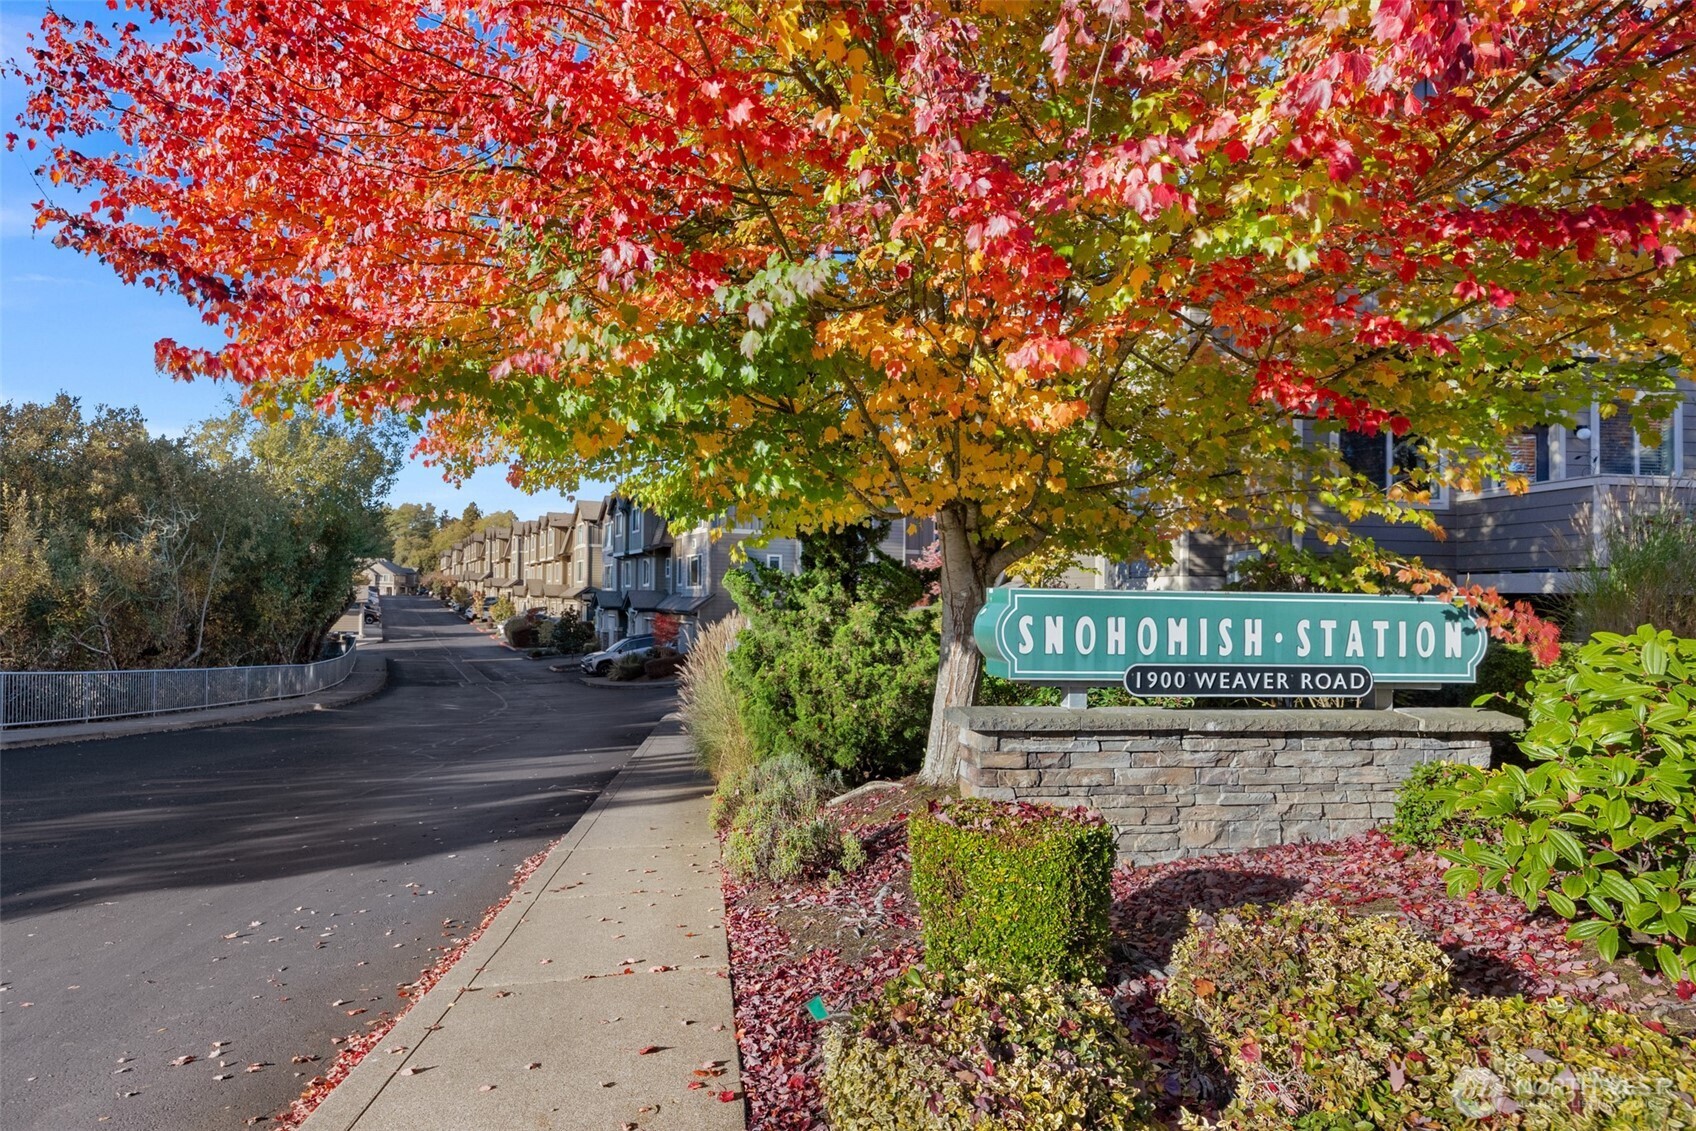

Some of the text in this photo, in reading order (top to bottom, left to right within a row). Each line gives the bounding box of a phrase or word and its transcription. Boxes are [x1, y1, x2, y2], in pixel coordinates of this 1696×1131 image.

[1018, 615, 1463, 658] SNOHOMISH STATION
[1135, 671, 1365, 690] 1900 WEAVER ROAD
